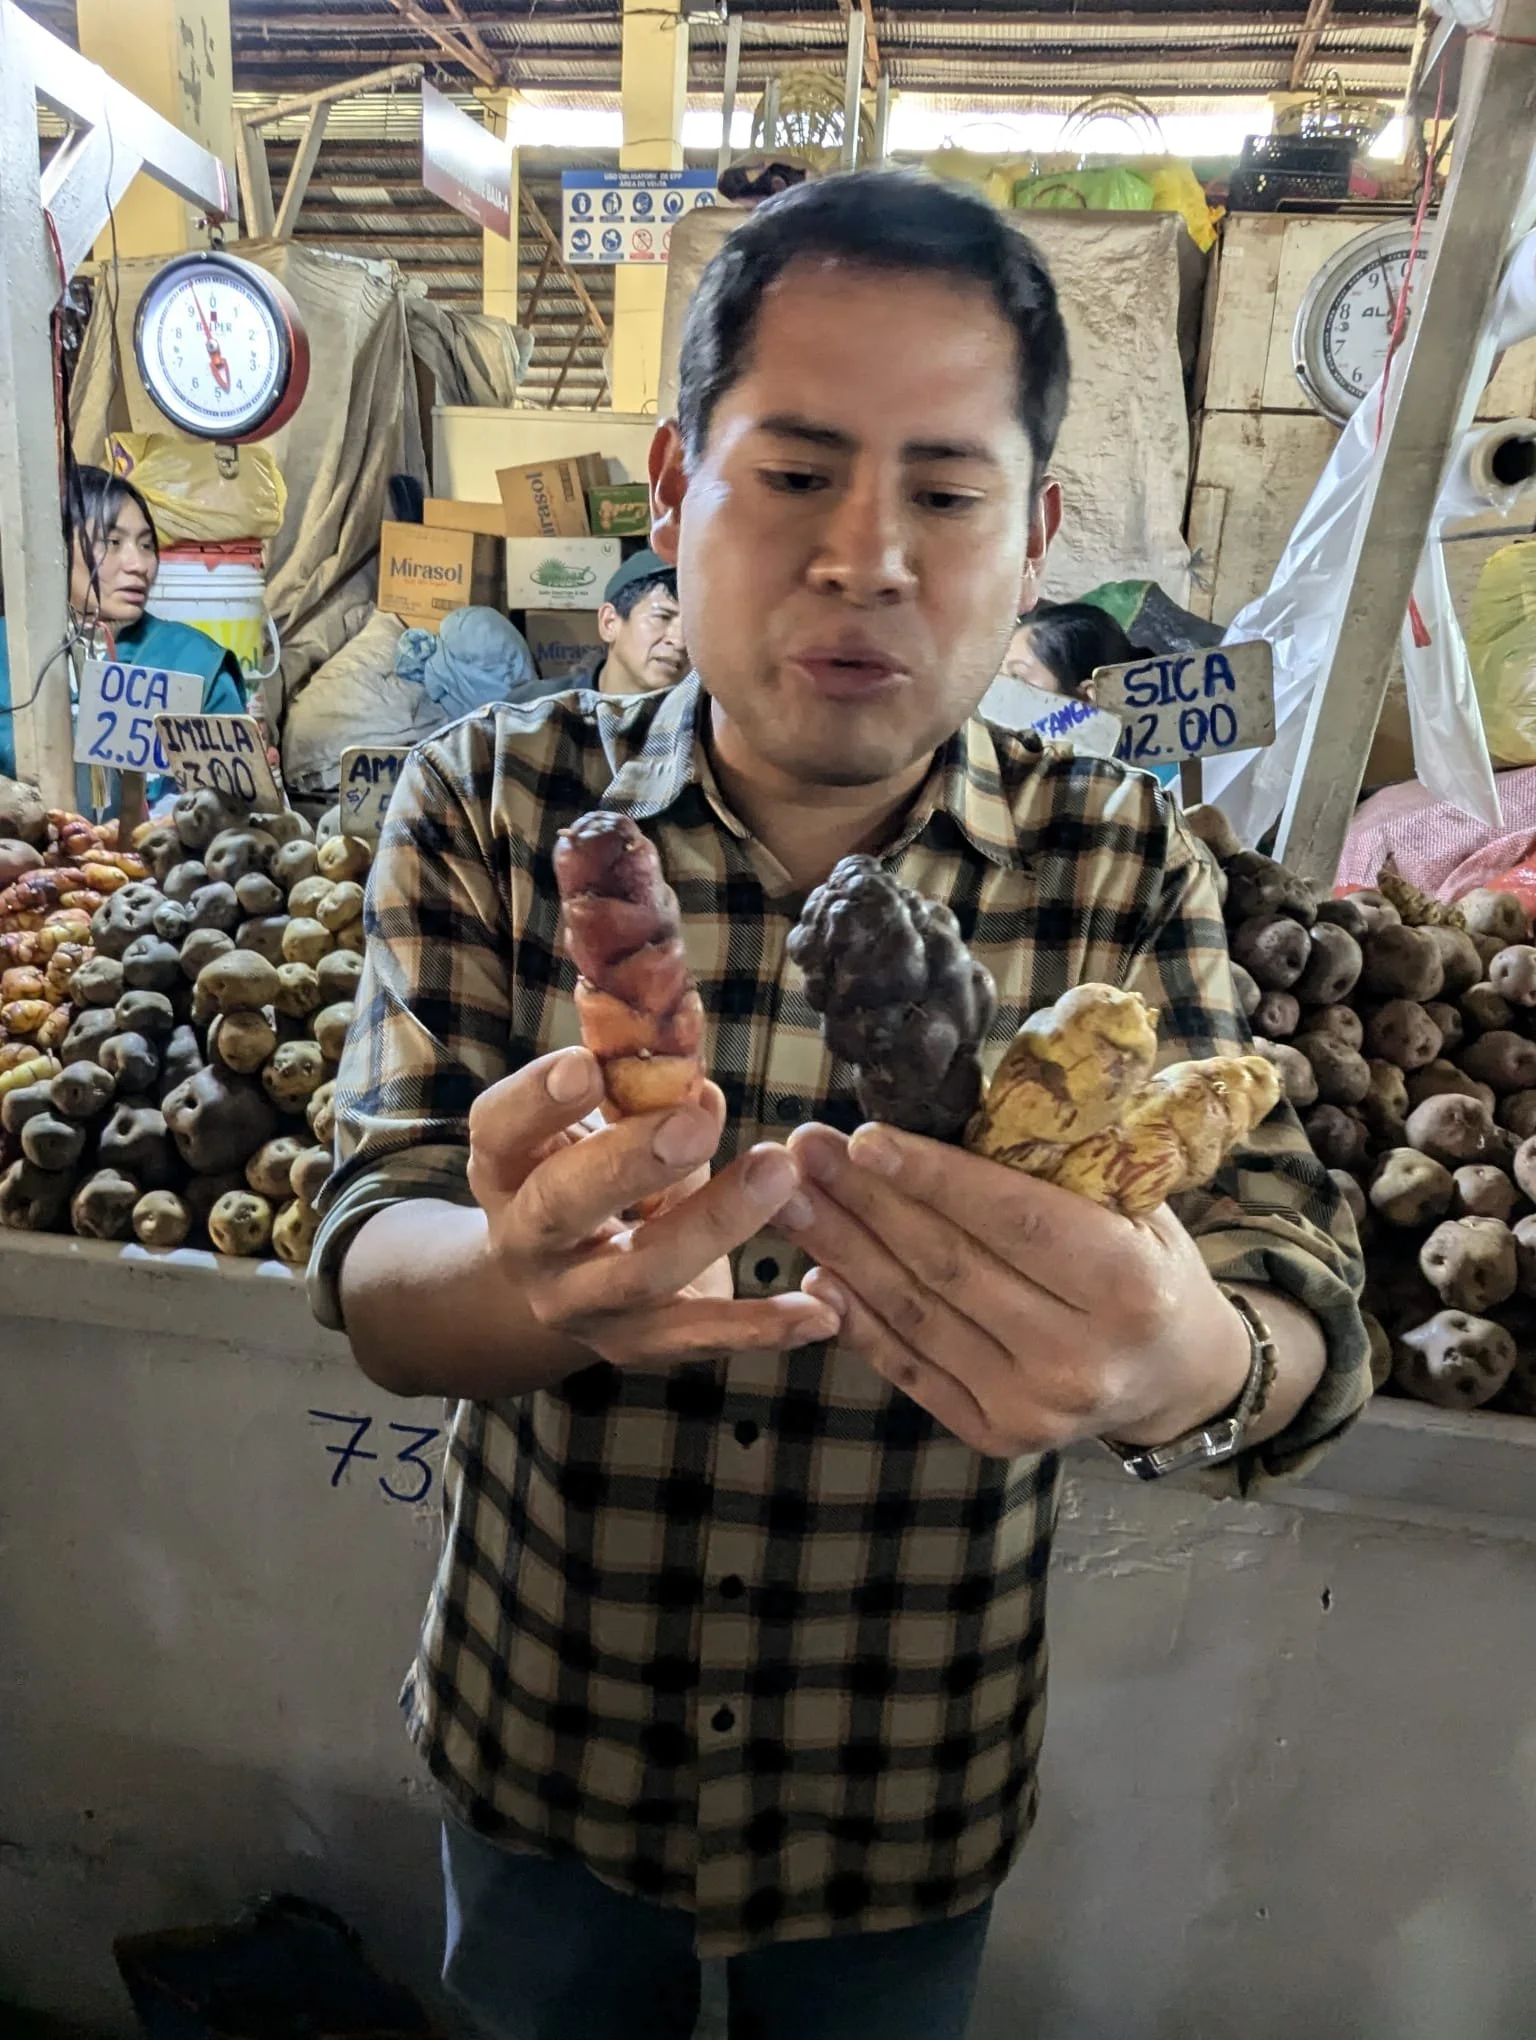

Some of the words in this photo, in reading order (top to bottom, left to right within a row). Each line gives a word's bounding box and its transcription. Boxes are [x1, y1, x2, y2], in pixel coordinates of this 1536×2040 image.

[1368, 272, 1380, 289] 9
[209, 296, 217, 308] 0
[1339, 304, 1351, 320] 8
[1335, 339, 1347, 356] 7
[1352, 366, 1363, 383] 6
[390, 555, 464, 585] Mirasol
[100, 665, 169, 709] OCA
[1123, 653, 1236, 708] SICA
[160, 718, 254, 753] IMILLA
[308, 1409, 440, 1502] 73
